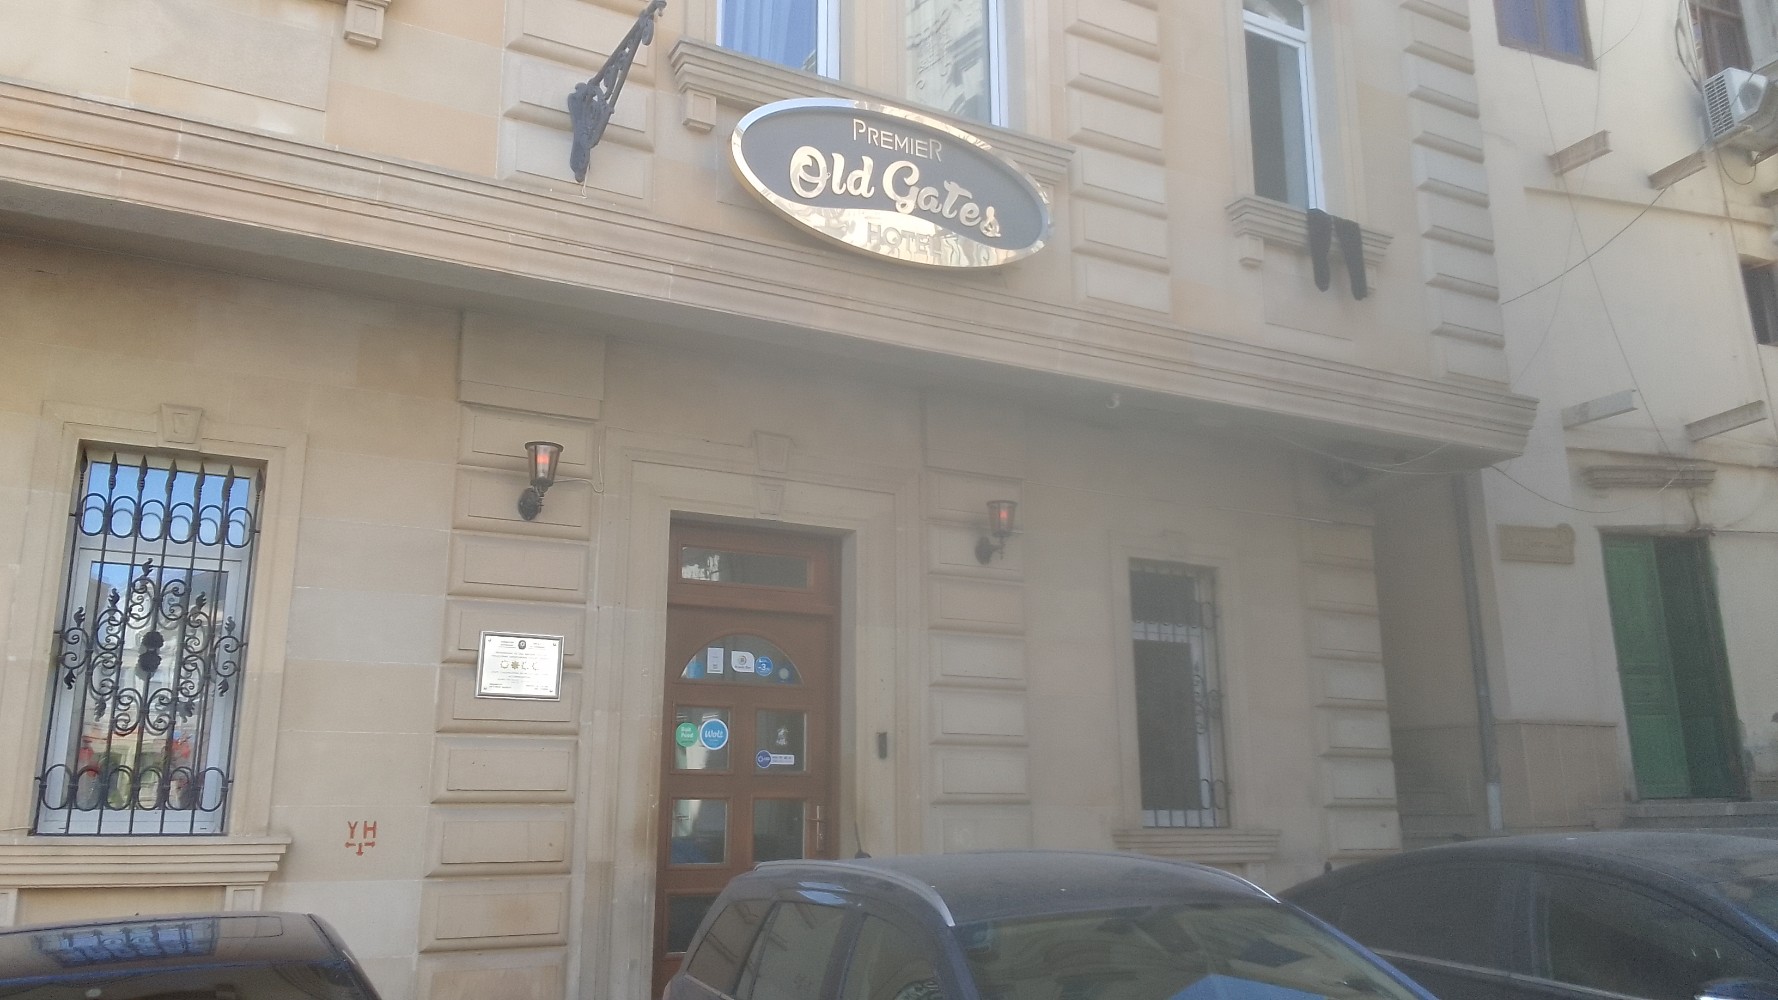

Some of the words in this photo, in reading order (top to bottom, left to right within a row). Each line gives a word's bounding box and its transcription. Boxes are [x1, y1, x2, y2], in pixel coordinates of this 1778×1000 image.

[853, 118, 942, 162] PREMIER
[789, 145, 875, 199] Old
[882, 160, 1001, 238] Gates
[866, 221, 942, 256] HOTEL
[704, 729, 724, 739] Wolt
